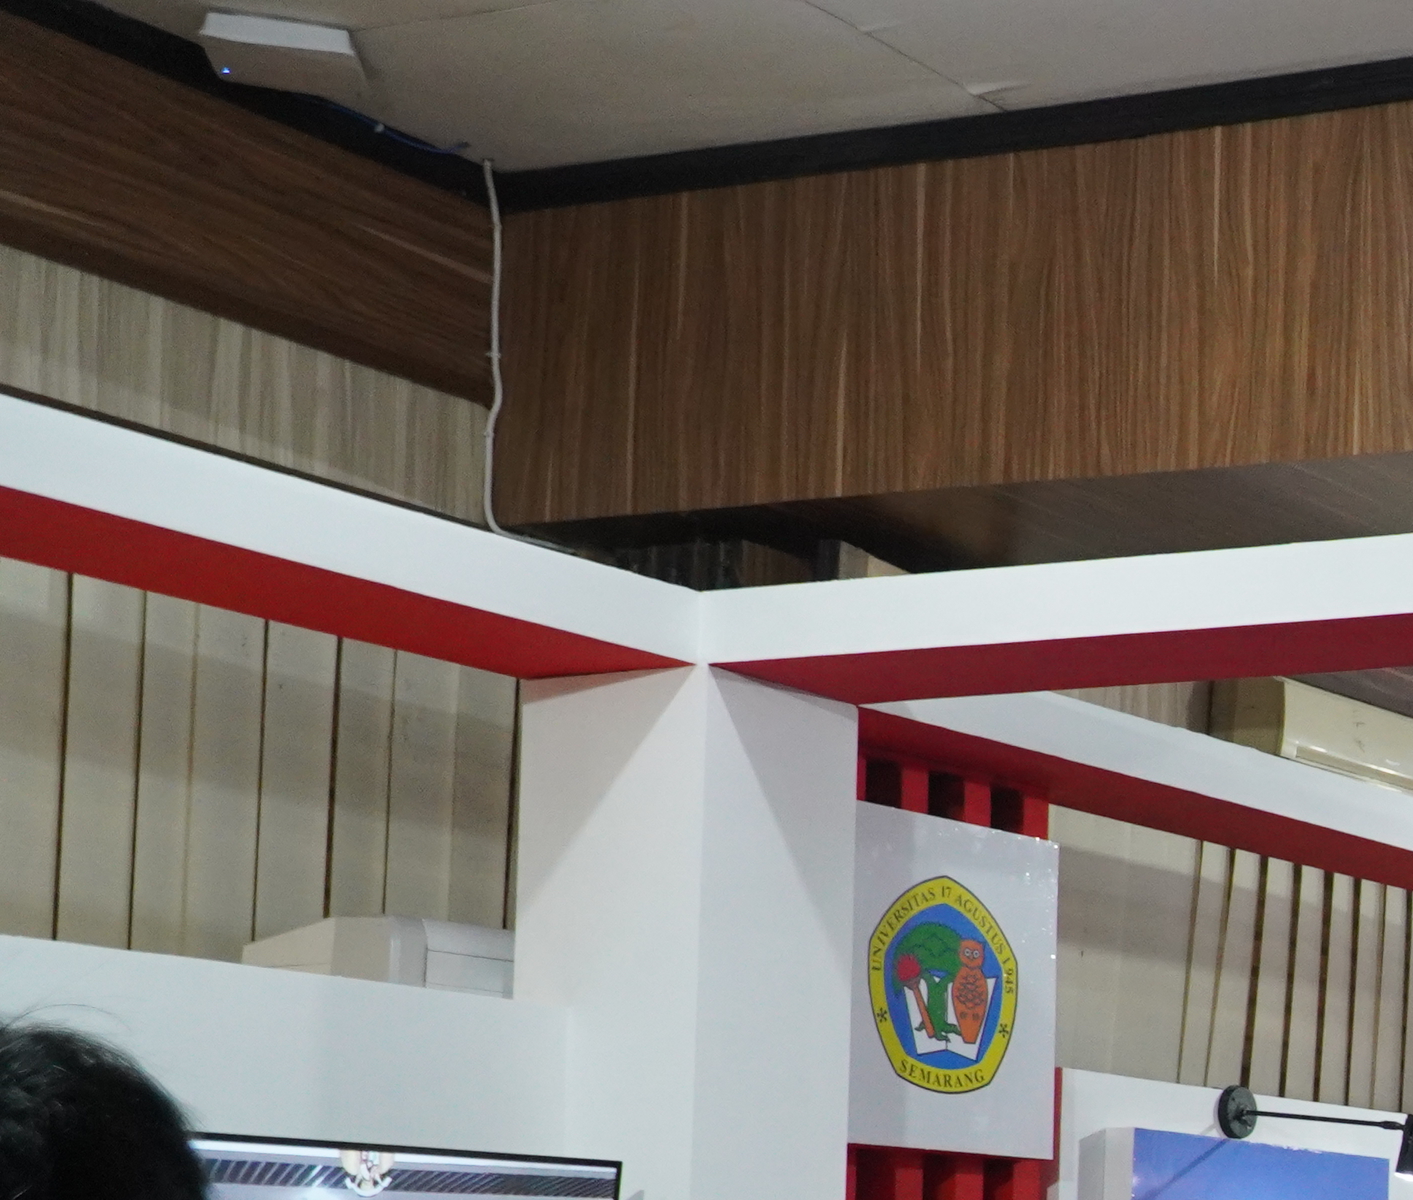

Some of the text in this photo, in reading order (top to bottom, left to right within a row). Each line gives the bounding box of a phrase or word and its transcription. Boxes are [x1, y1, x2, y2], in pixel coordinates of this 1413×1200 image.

[870, 886, 1014, 995] UNIVERSITAS 17 AGUSTUS 1945
[899, 1059, 986, 1088] SEMARANG
